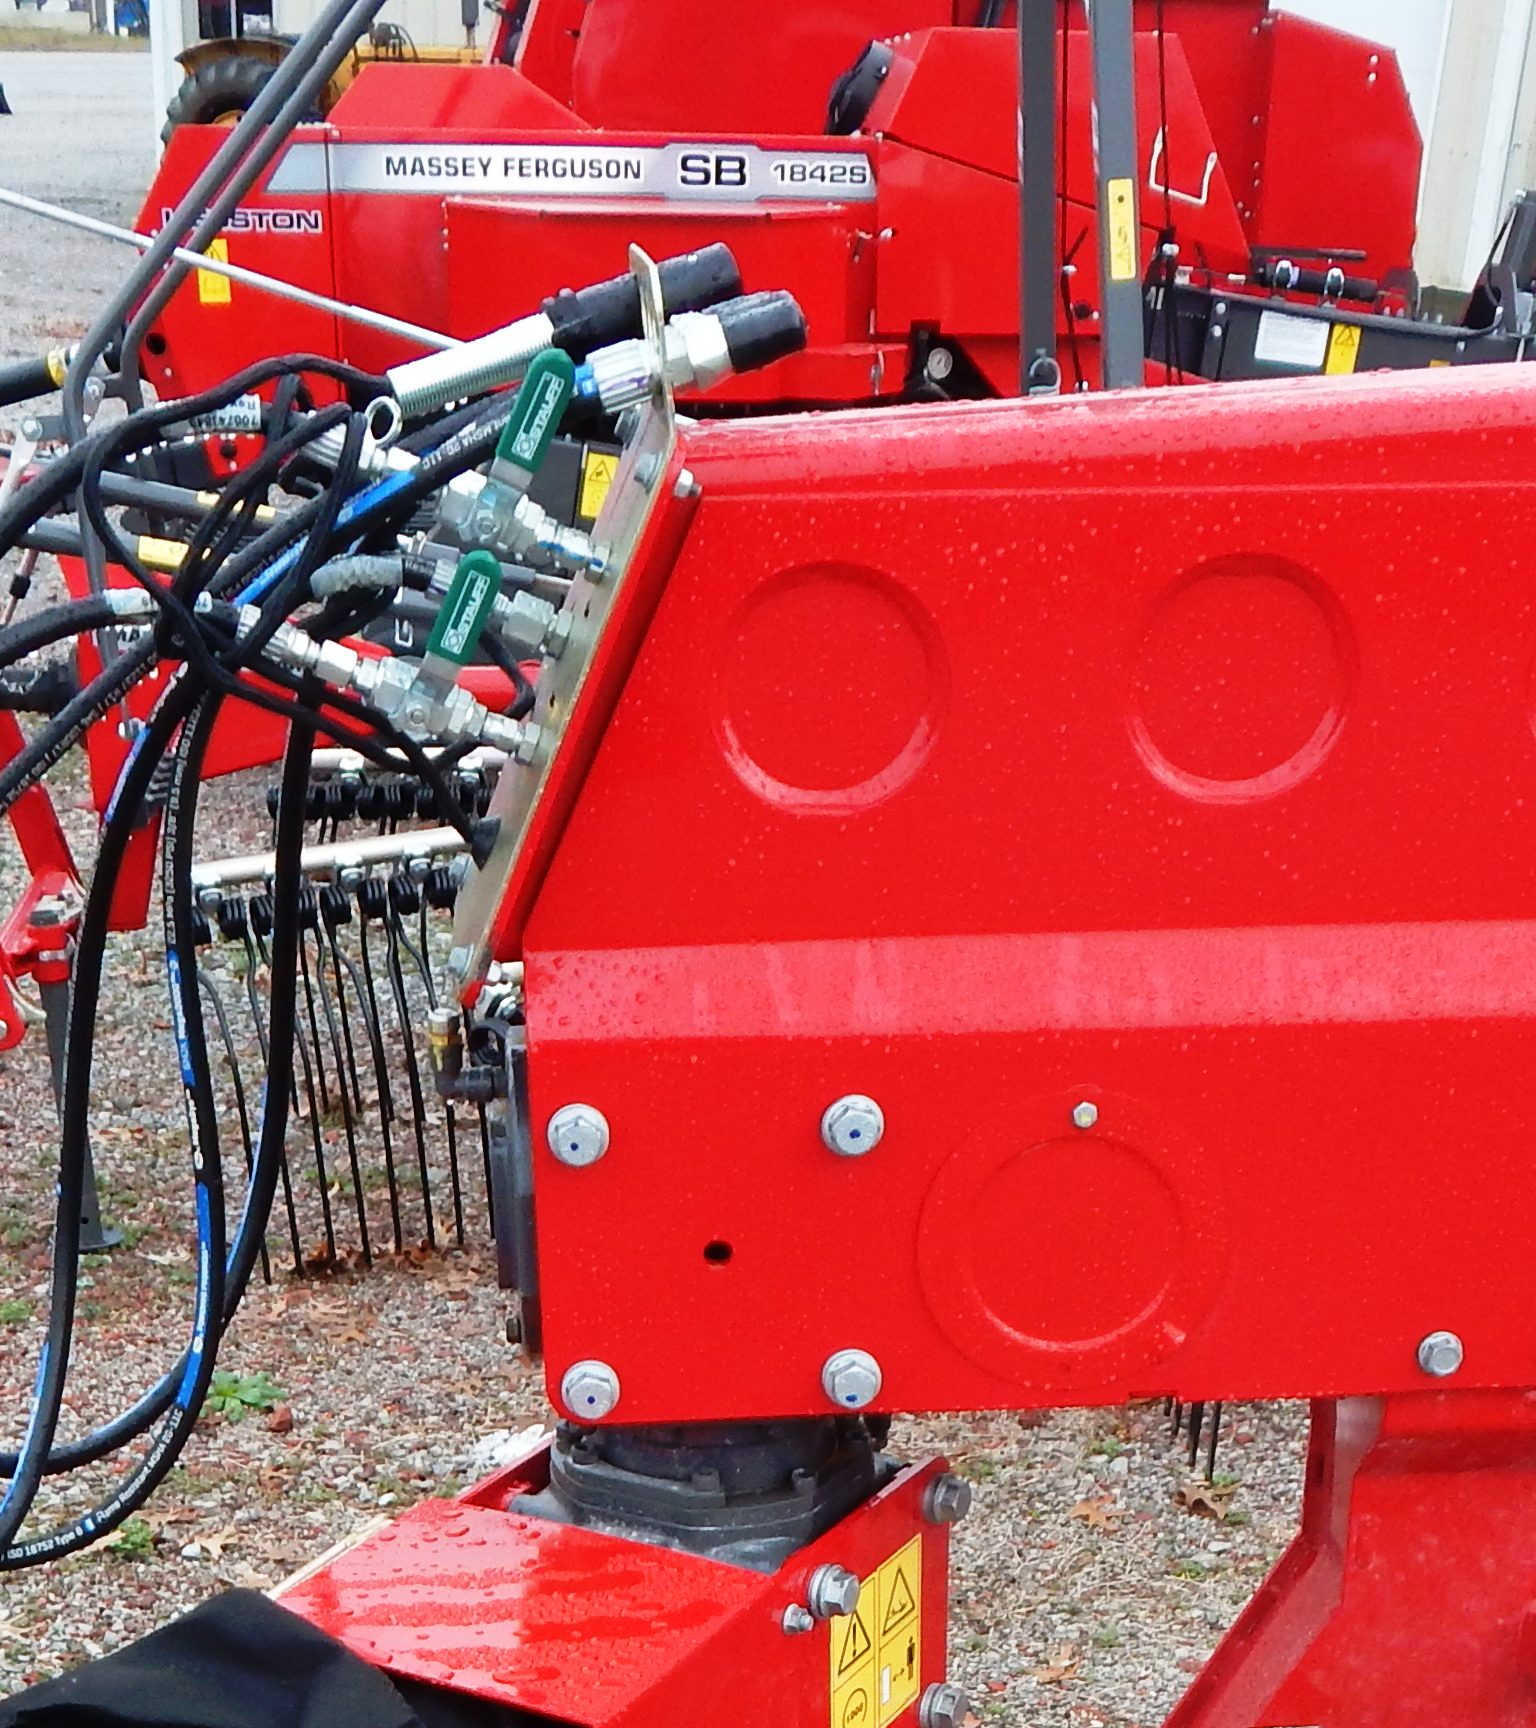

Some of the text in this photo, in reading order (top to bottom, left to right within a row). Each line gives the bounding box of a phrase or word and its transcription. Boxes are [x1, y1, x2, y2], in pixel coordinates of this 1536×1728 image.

[385, 154, 492, 179] MASSEY
[503, 155, 642, 181] FERGUSON
[679, 151, 748, 187] SB
[529, 376, 564, 439] STAUFF
[458, 576, 490, 633] STAUFF
